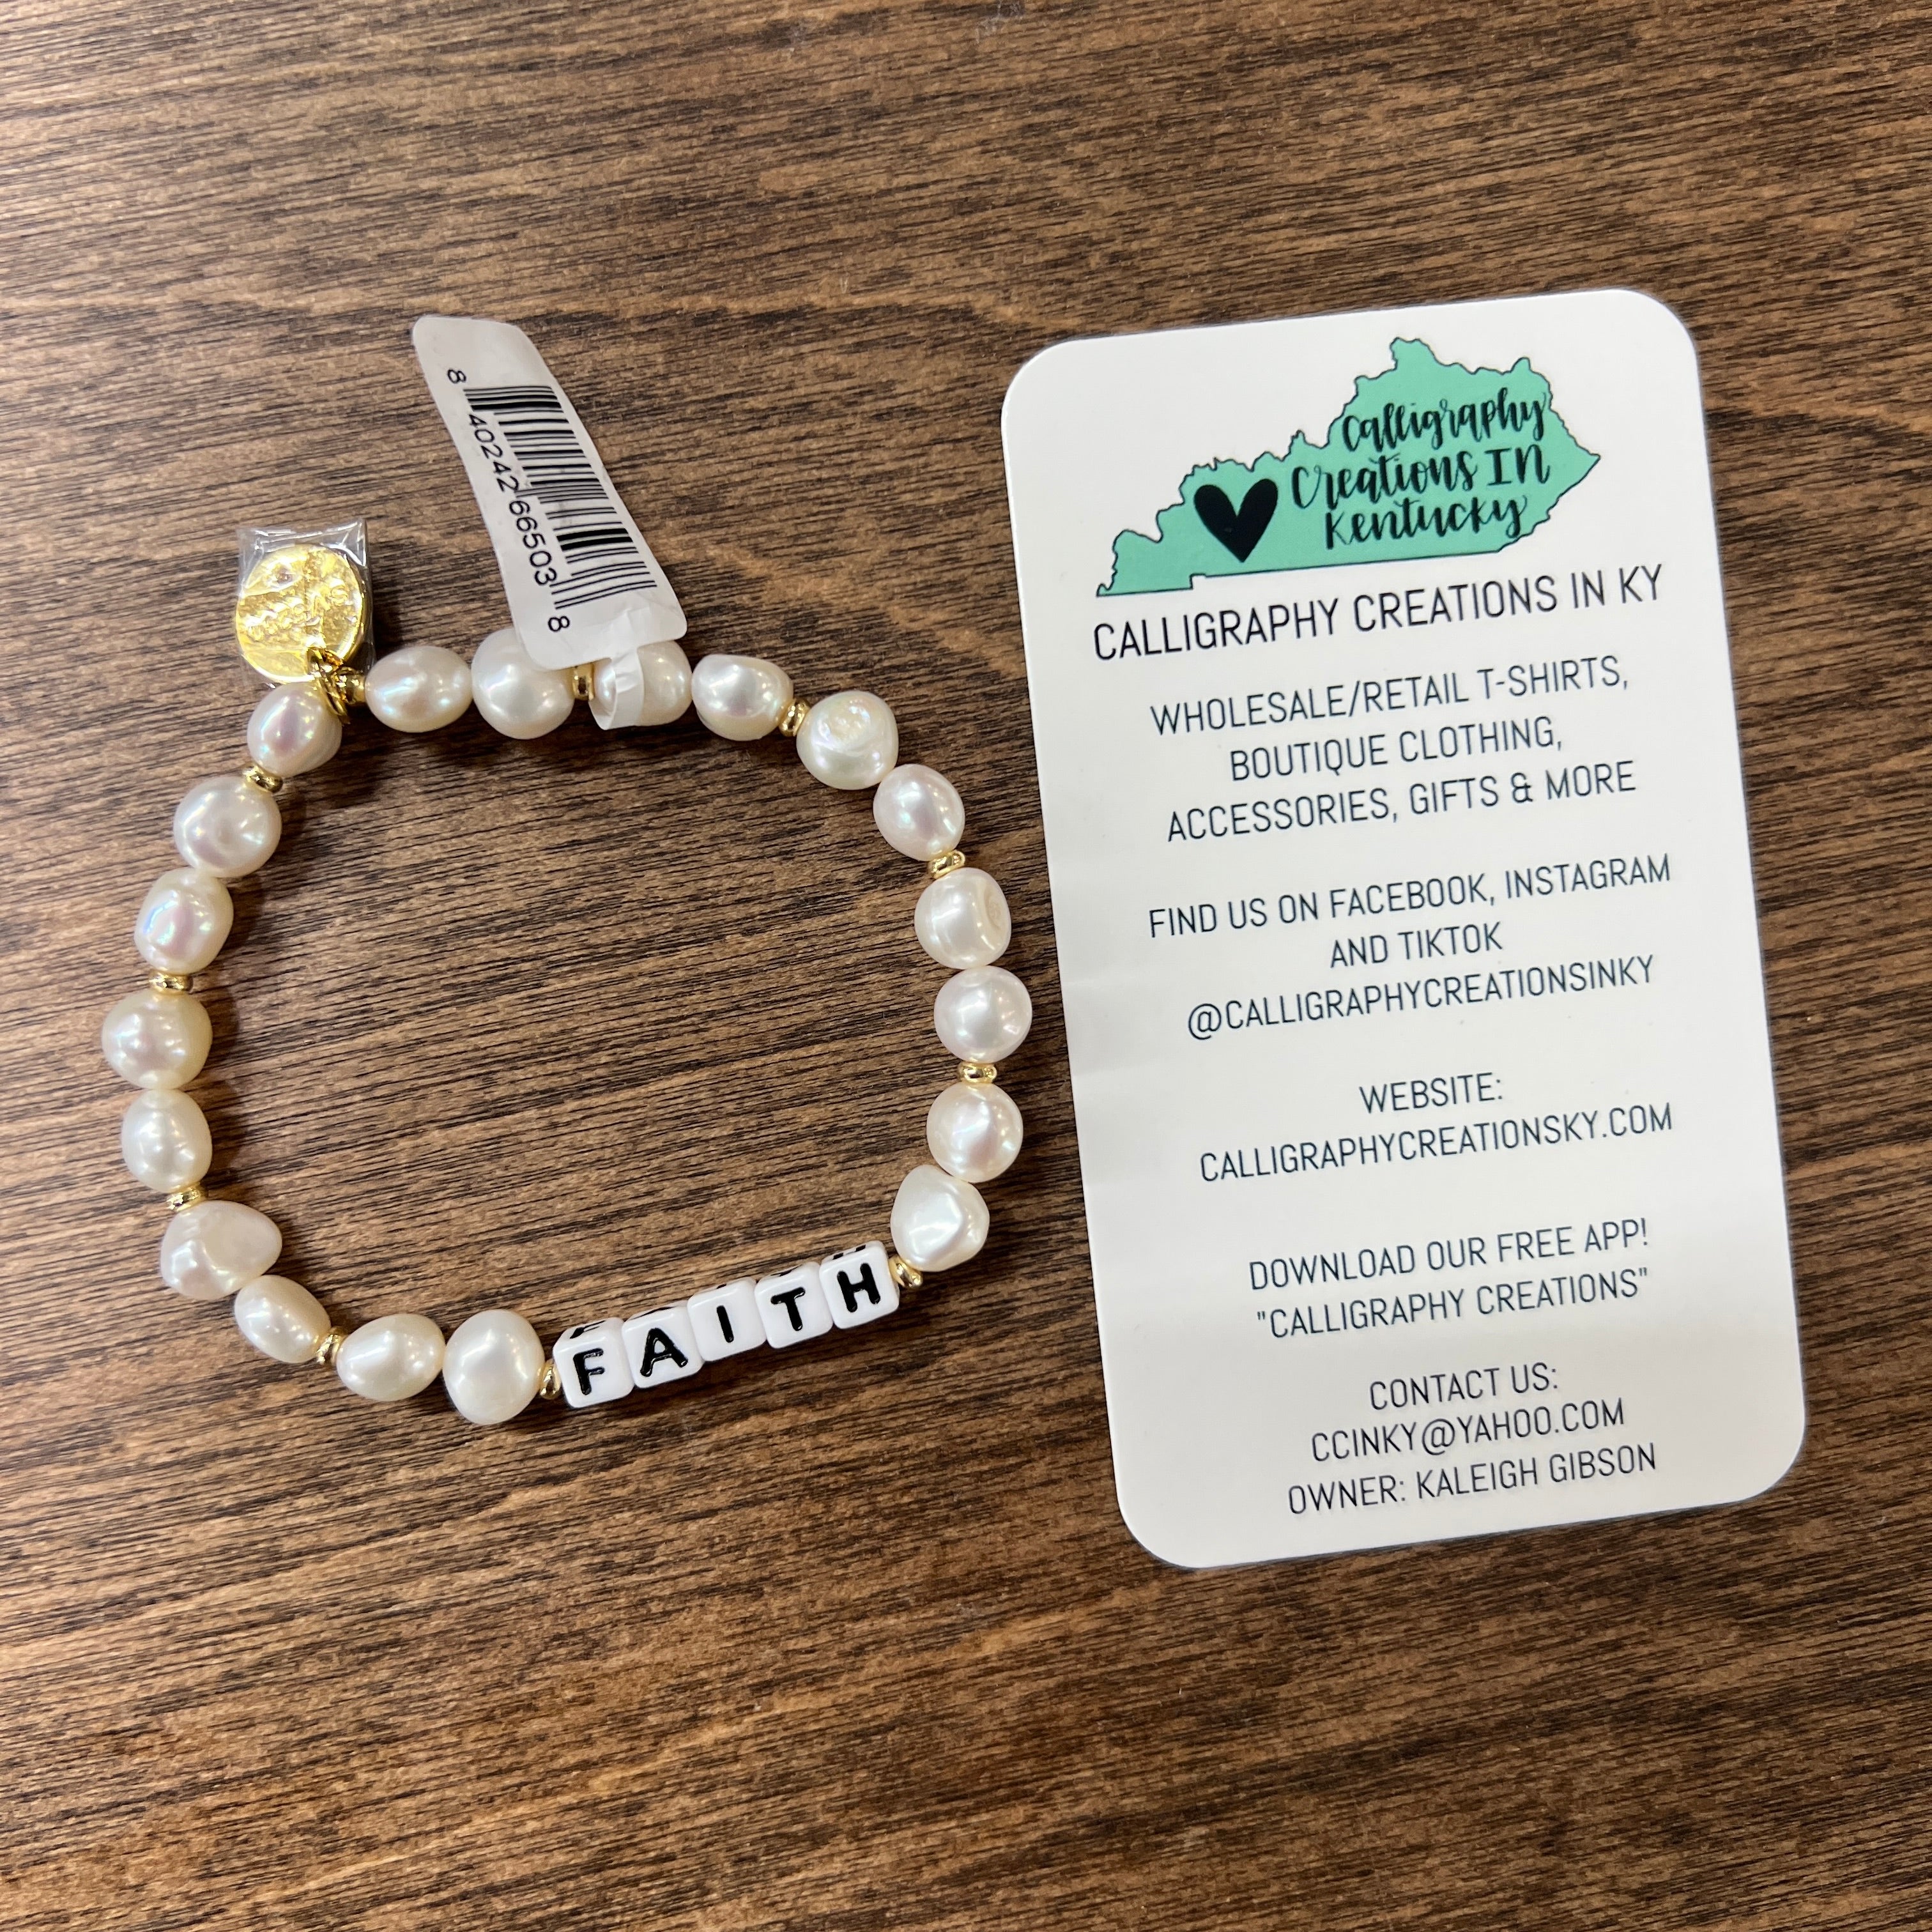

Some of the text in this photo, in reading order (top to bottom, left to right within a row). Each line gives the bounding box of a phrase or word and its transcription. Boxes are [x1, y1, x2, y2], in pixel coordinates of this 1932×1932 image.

[1342, 387, 1547, 452] Calligraphy
[447, 369, 570, 632] 8 40242 66503 8
[1292, 450, 1478, 510] Creations
[1325, 495, 1528, 549] Kentucky
[1093, 564, 1662, 661] CALLIGRAPHY CREATIONS IN KY
[1149, 655, 1628, 736] WHOLESALE/RETAIL T-SHIRTS,
[1230, 716, 1562, 782] BOUTIQUE CLOTHING,
[1167, 760, 1637, 843] ACCESSORIES, GIFTS & MORE
[1149, 852, 1671, 939] FIND US ON FACEBOOK, INSTAGRAM
[1330, 921, 1503, 969] AND TIKTOK
[1187, 954, 1653, 1041] @CALLIGRAPHYCREATIONSINKY
[1358, 1071, 1503, 1114] WEBSITE:
[1200, 1102, 1673, 1182] CALLIGRAPHYCREATIONSKY.COM
[1249, 1217, 1648, 1291] DOWNLOAD OUR FREE APP!
[572, 1262, 882, 1395] FAITH
[1257, 1267, 1648, 1338] "CALLIGRAPHY CREATIONS"
[1369, 1361, 1558, 1411] CONTACT US:
[1311, 1397, 1625, 1462] CCINKY@YAHOO.COM
[1288, 1442, 1656, 1515] OWNER: KALEIGH GIBSON
